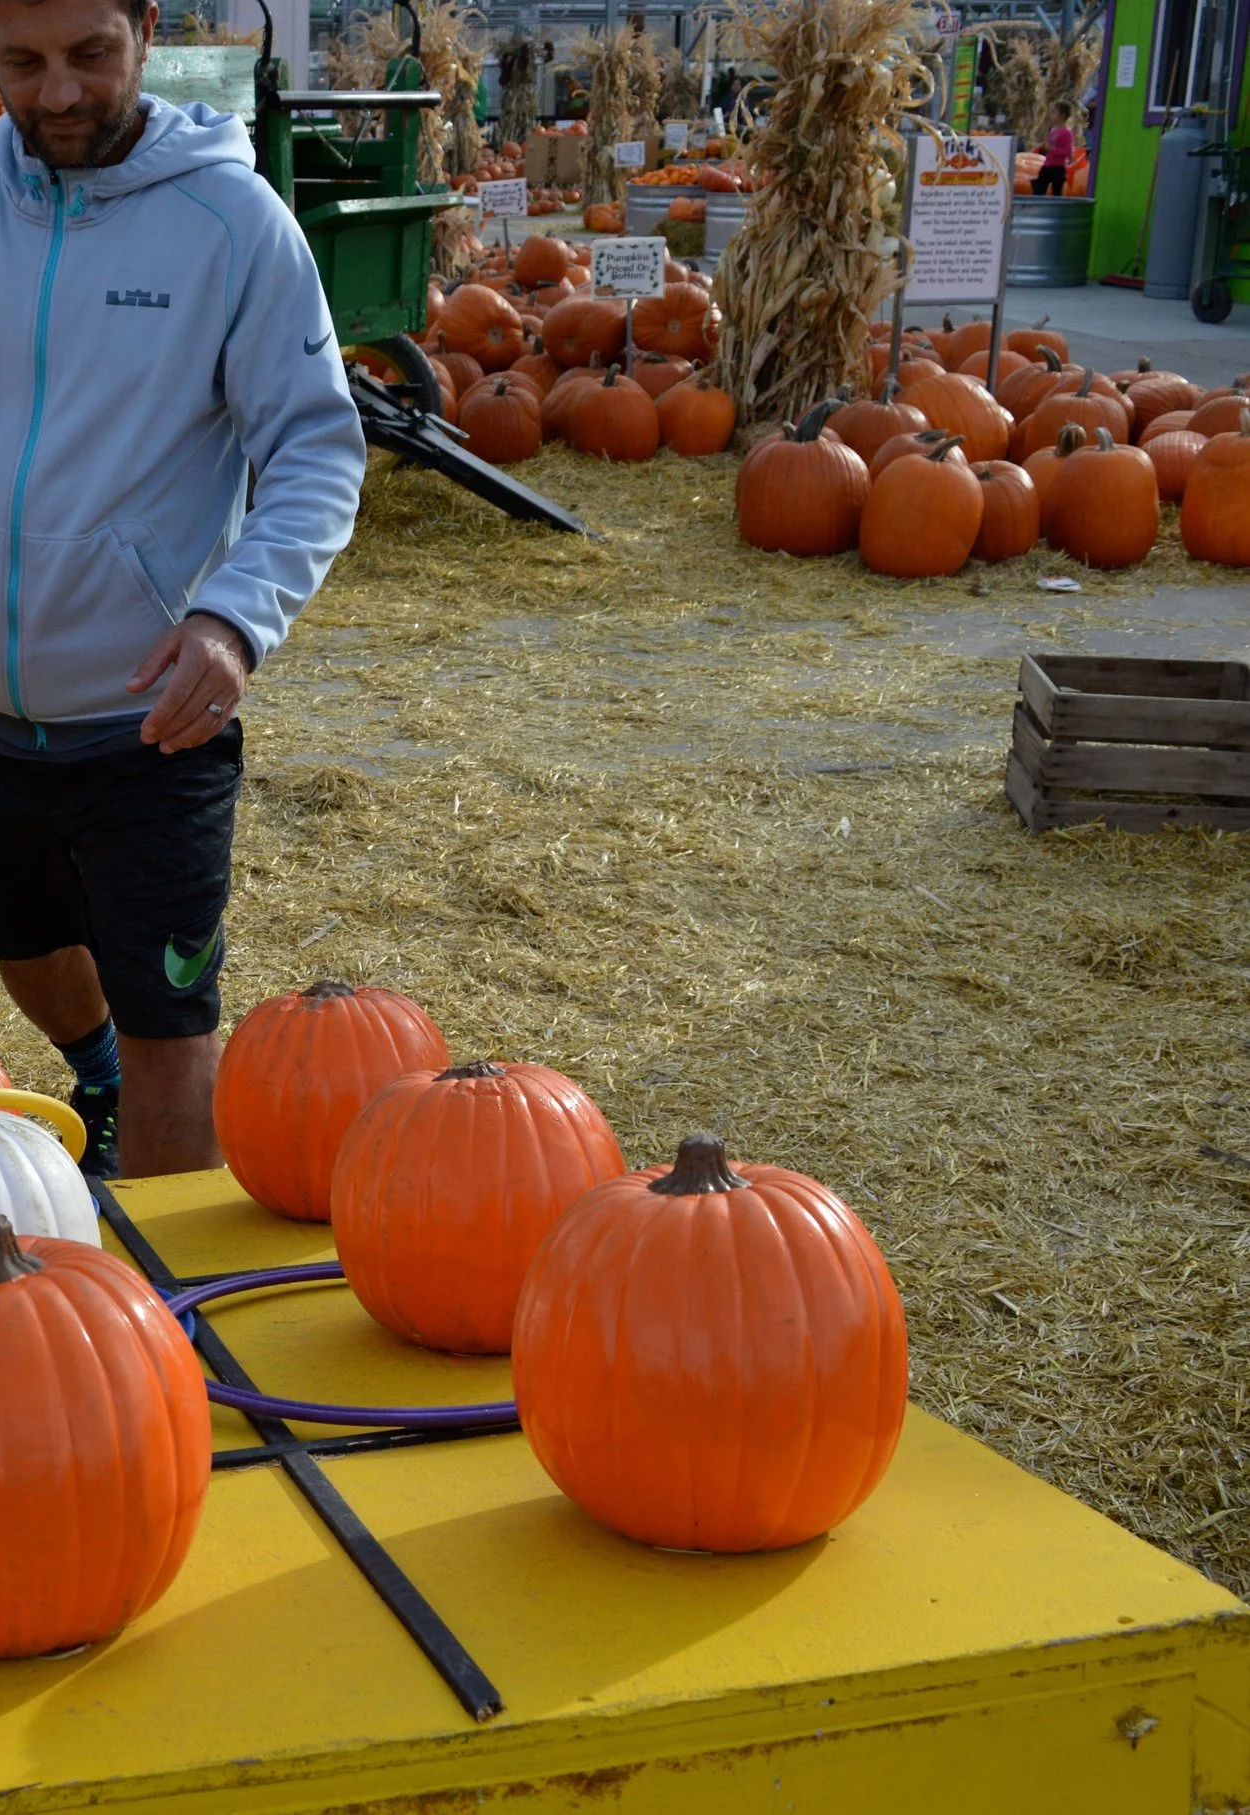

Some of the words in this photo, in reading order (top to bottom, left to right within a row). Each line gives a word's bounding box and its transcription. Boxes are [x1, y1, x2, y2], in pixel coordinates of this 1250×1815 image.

[606, 252, 650, 263] Pumpkins
[606, 262, 635, 272] Priced
[637, 262, 650, 272] On
[611, 272, 645, 281] Bottom
